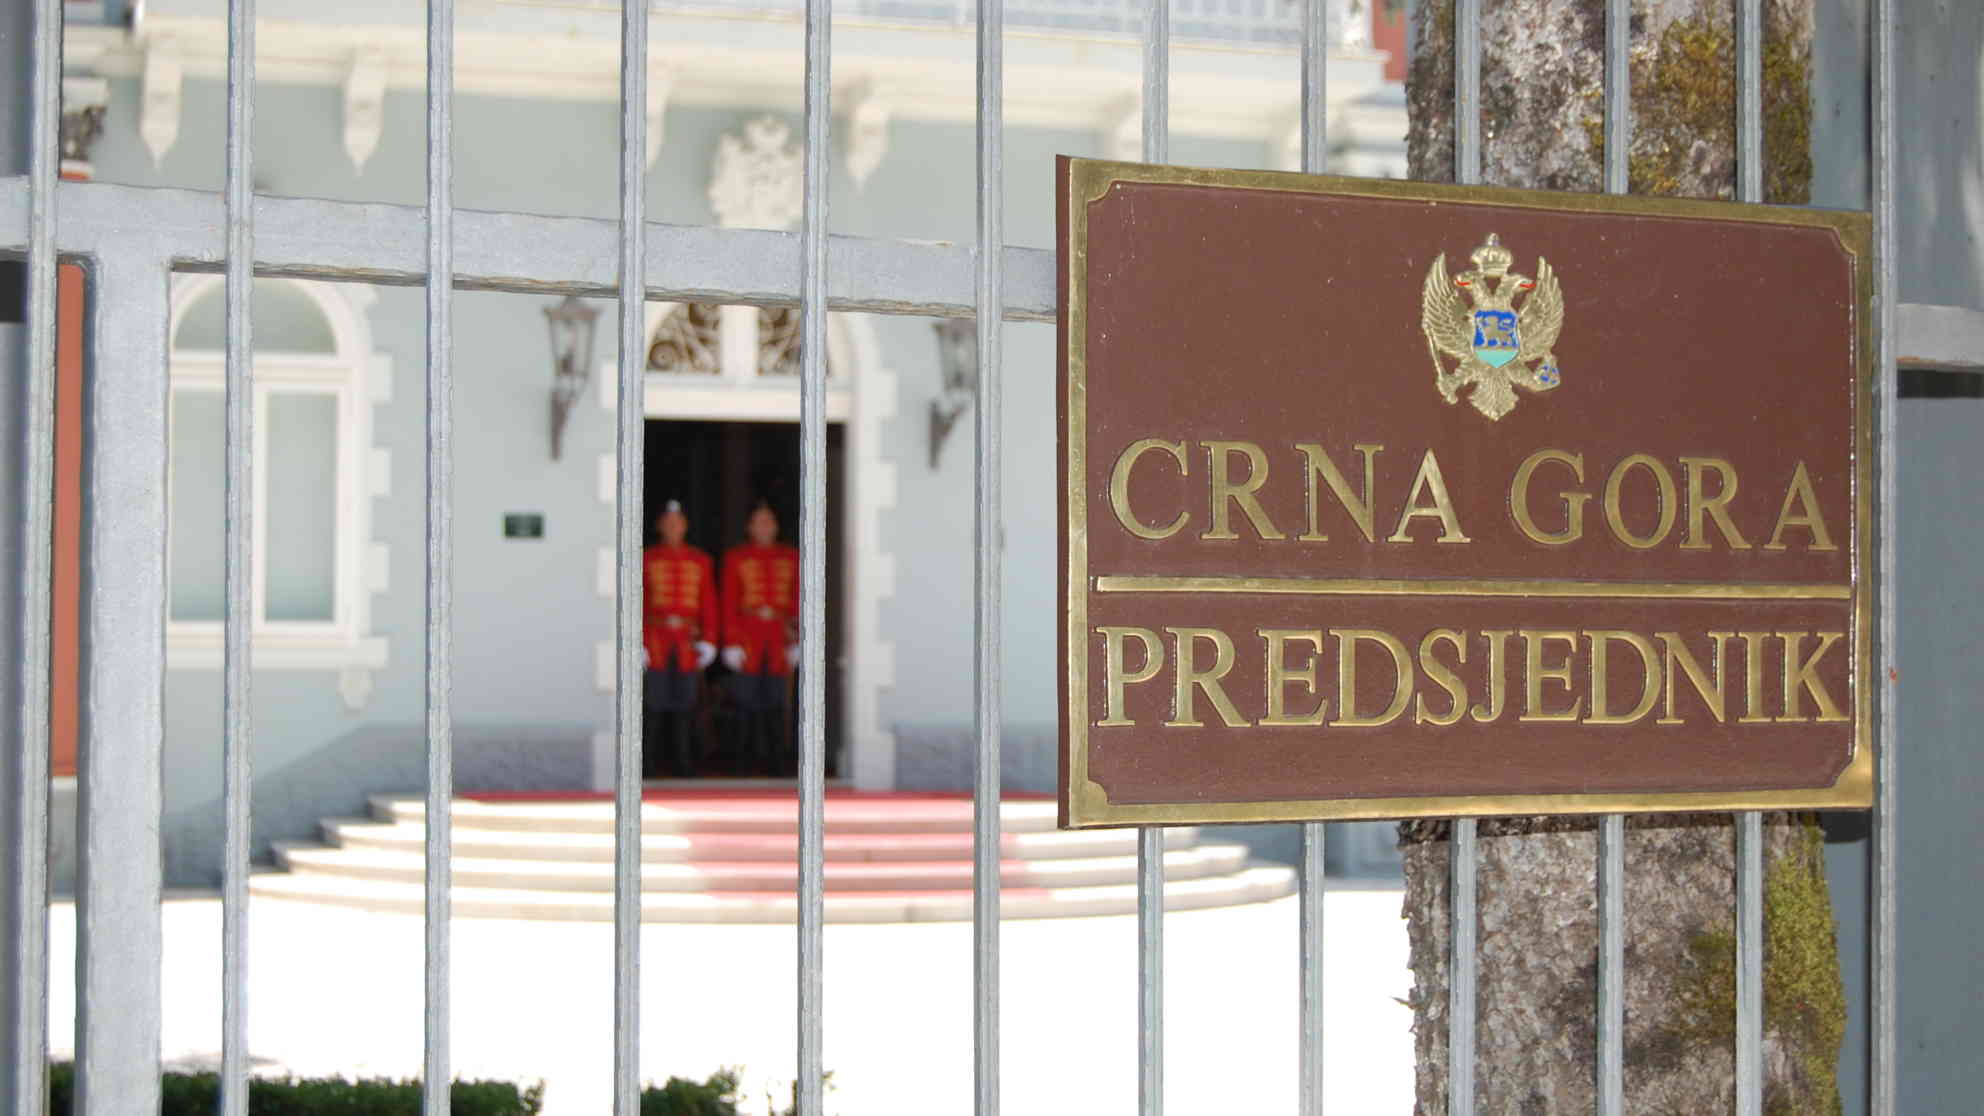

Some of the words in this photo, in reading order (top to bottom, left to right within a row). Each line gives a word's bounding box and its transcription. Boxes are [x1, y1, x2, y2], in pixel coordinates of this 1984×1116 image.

[1109, 438, 1471, 544] CRNA
[1510, 448, 1839, 551] GORA
[1094, 626, 1851, 729] PREDSJEDNIK
